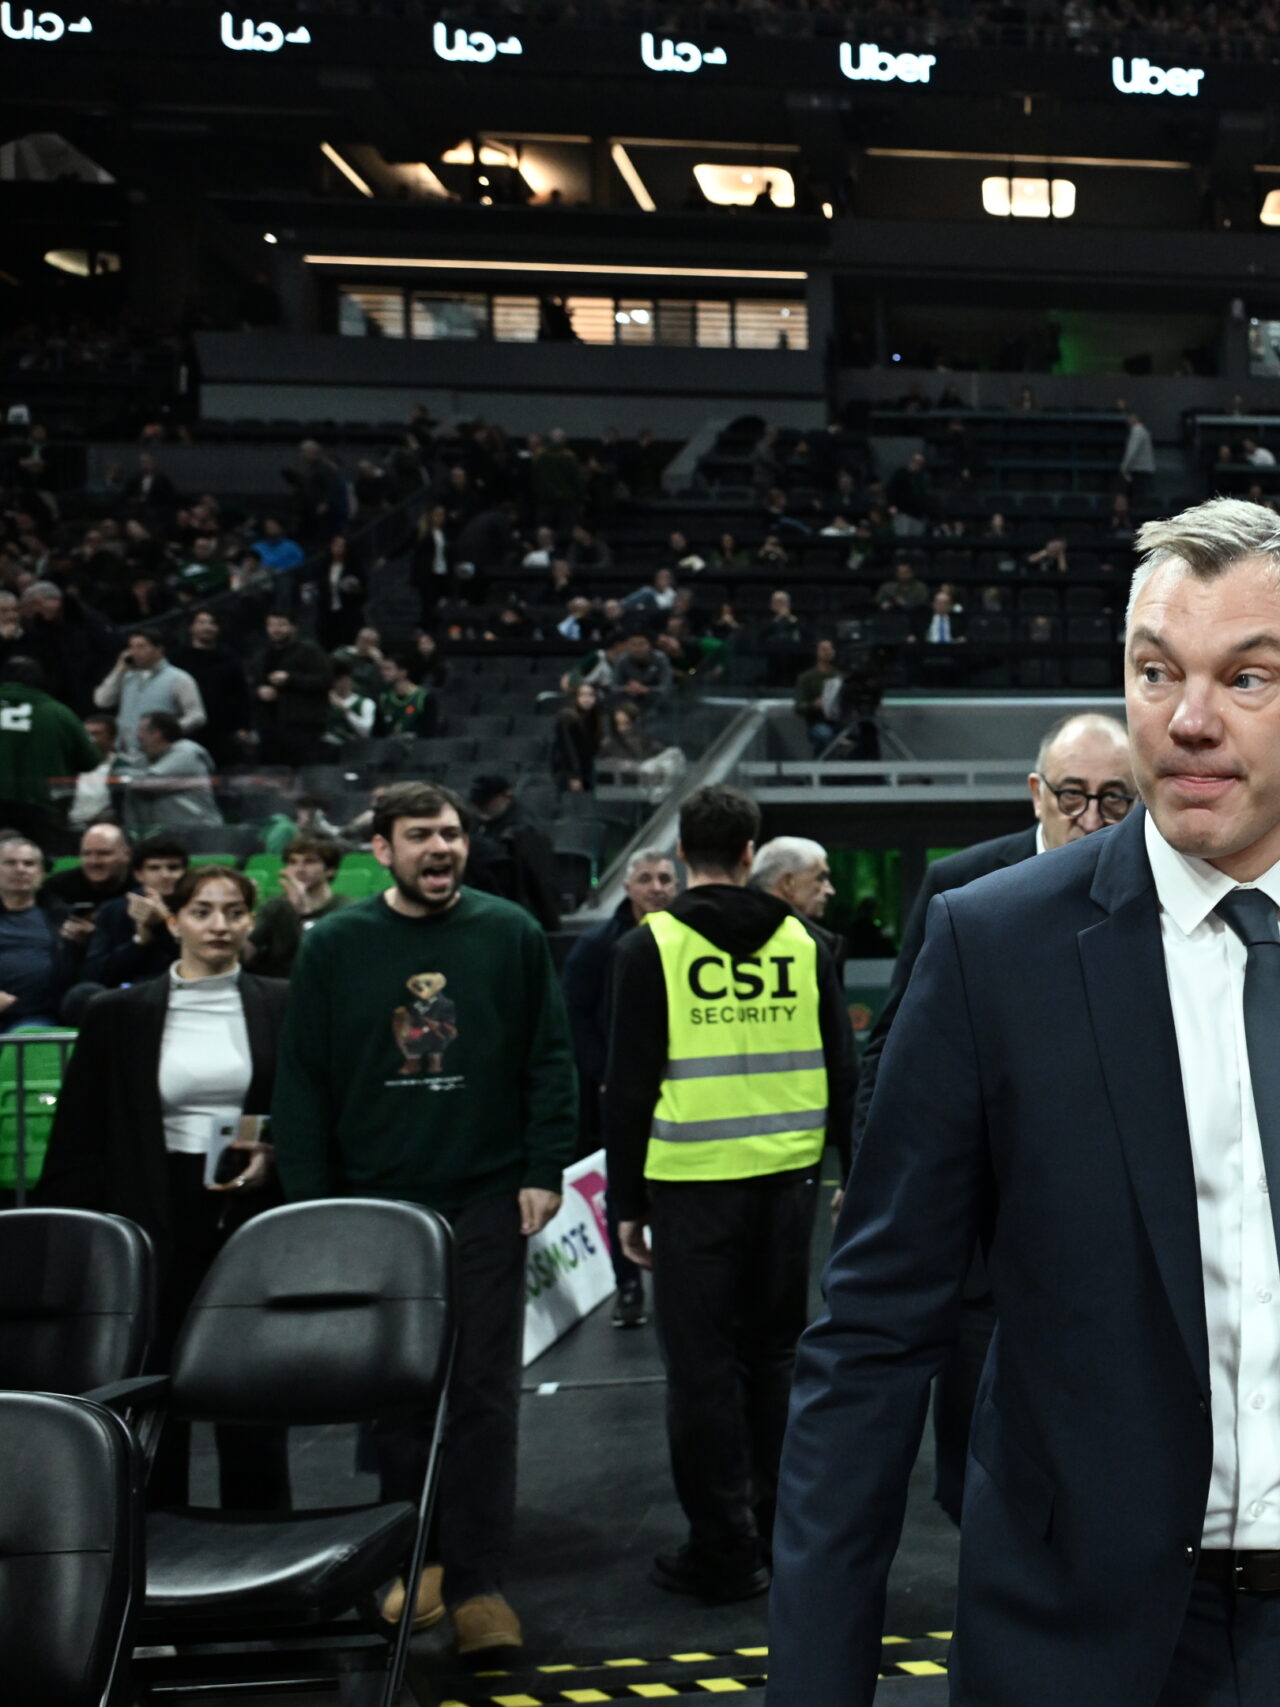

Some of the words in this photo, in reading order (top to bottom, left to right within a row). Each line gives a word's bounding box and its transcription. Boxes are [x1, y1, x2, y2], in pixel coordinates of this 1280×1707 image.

[840, 42, 936, 83] Uber
[1112, 57, 1204, 96] Uber
[688, 955, 797, 1001] CSI
[690, 1005, 797, 1025] SECURITY
[525, 1222, 596, 1298] OSMOTE
